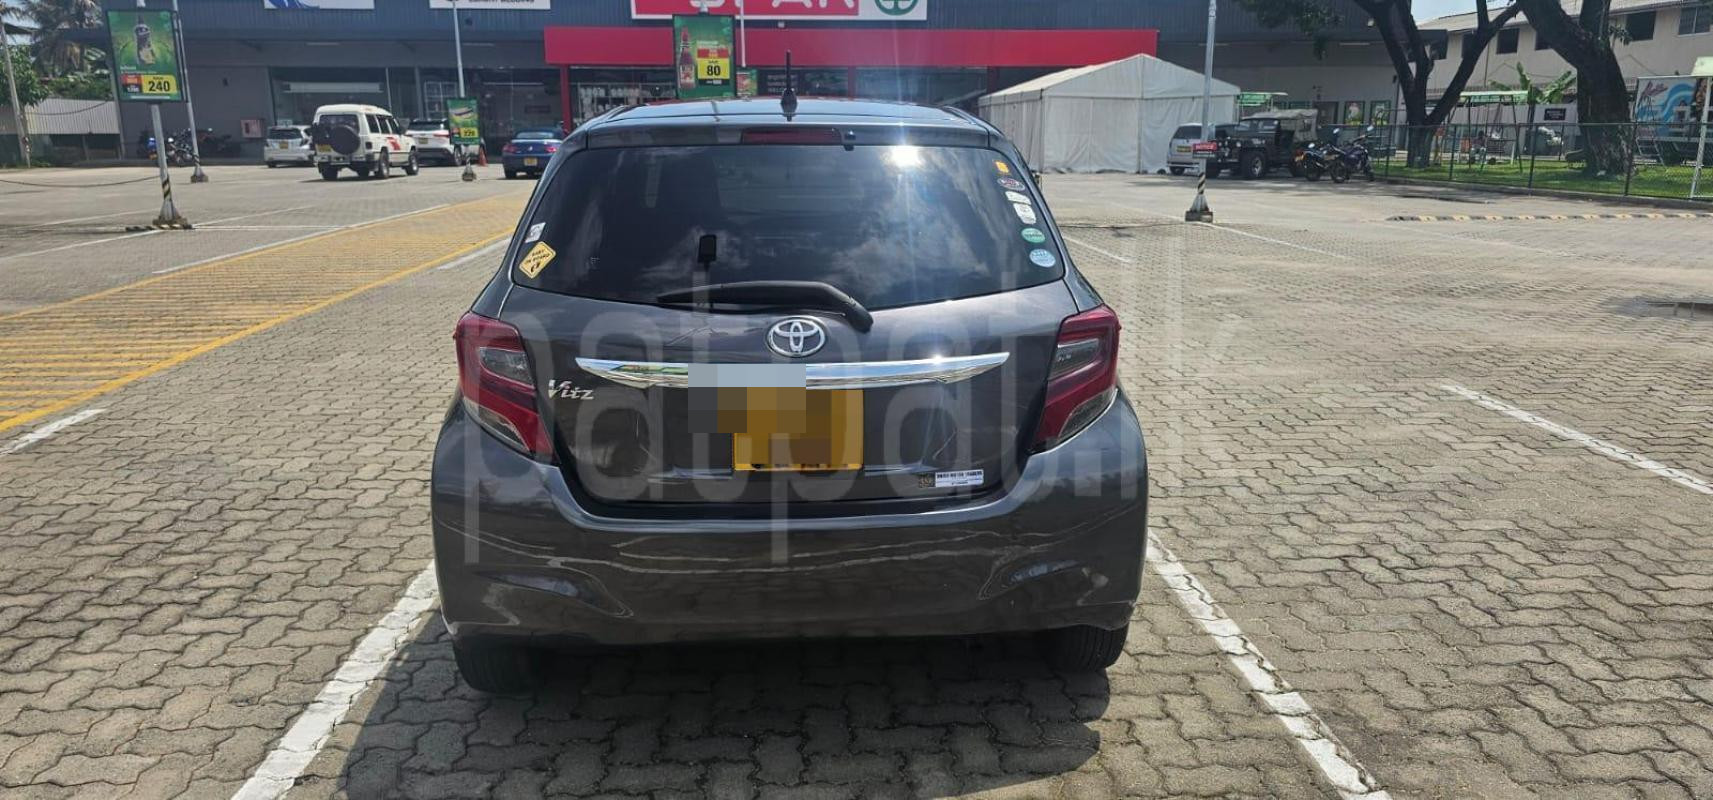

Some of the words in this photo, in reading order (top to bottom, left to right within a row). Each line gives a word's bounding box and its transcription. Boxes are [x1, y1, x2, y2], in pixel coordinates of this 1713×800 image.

[706, 65, 721, 76] 80
[148, 80, 171, 92] 240
[548, 379, 594, 400] Vitz
